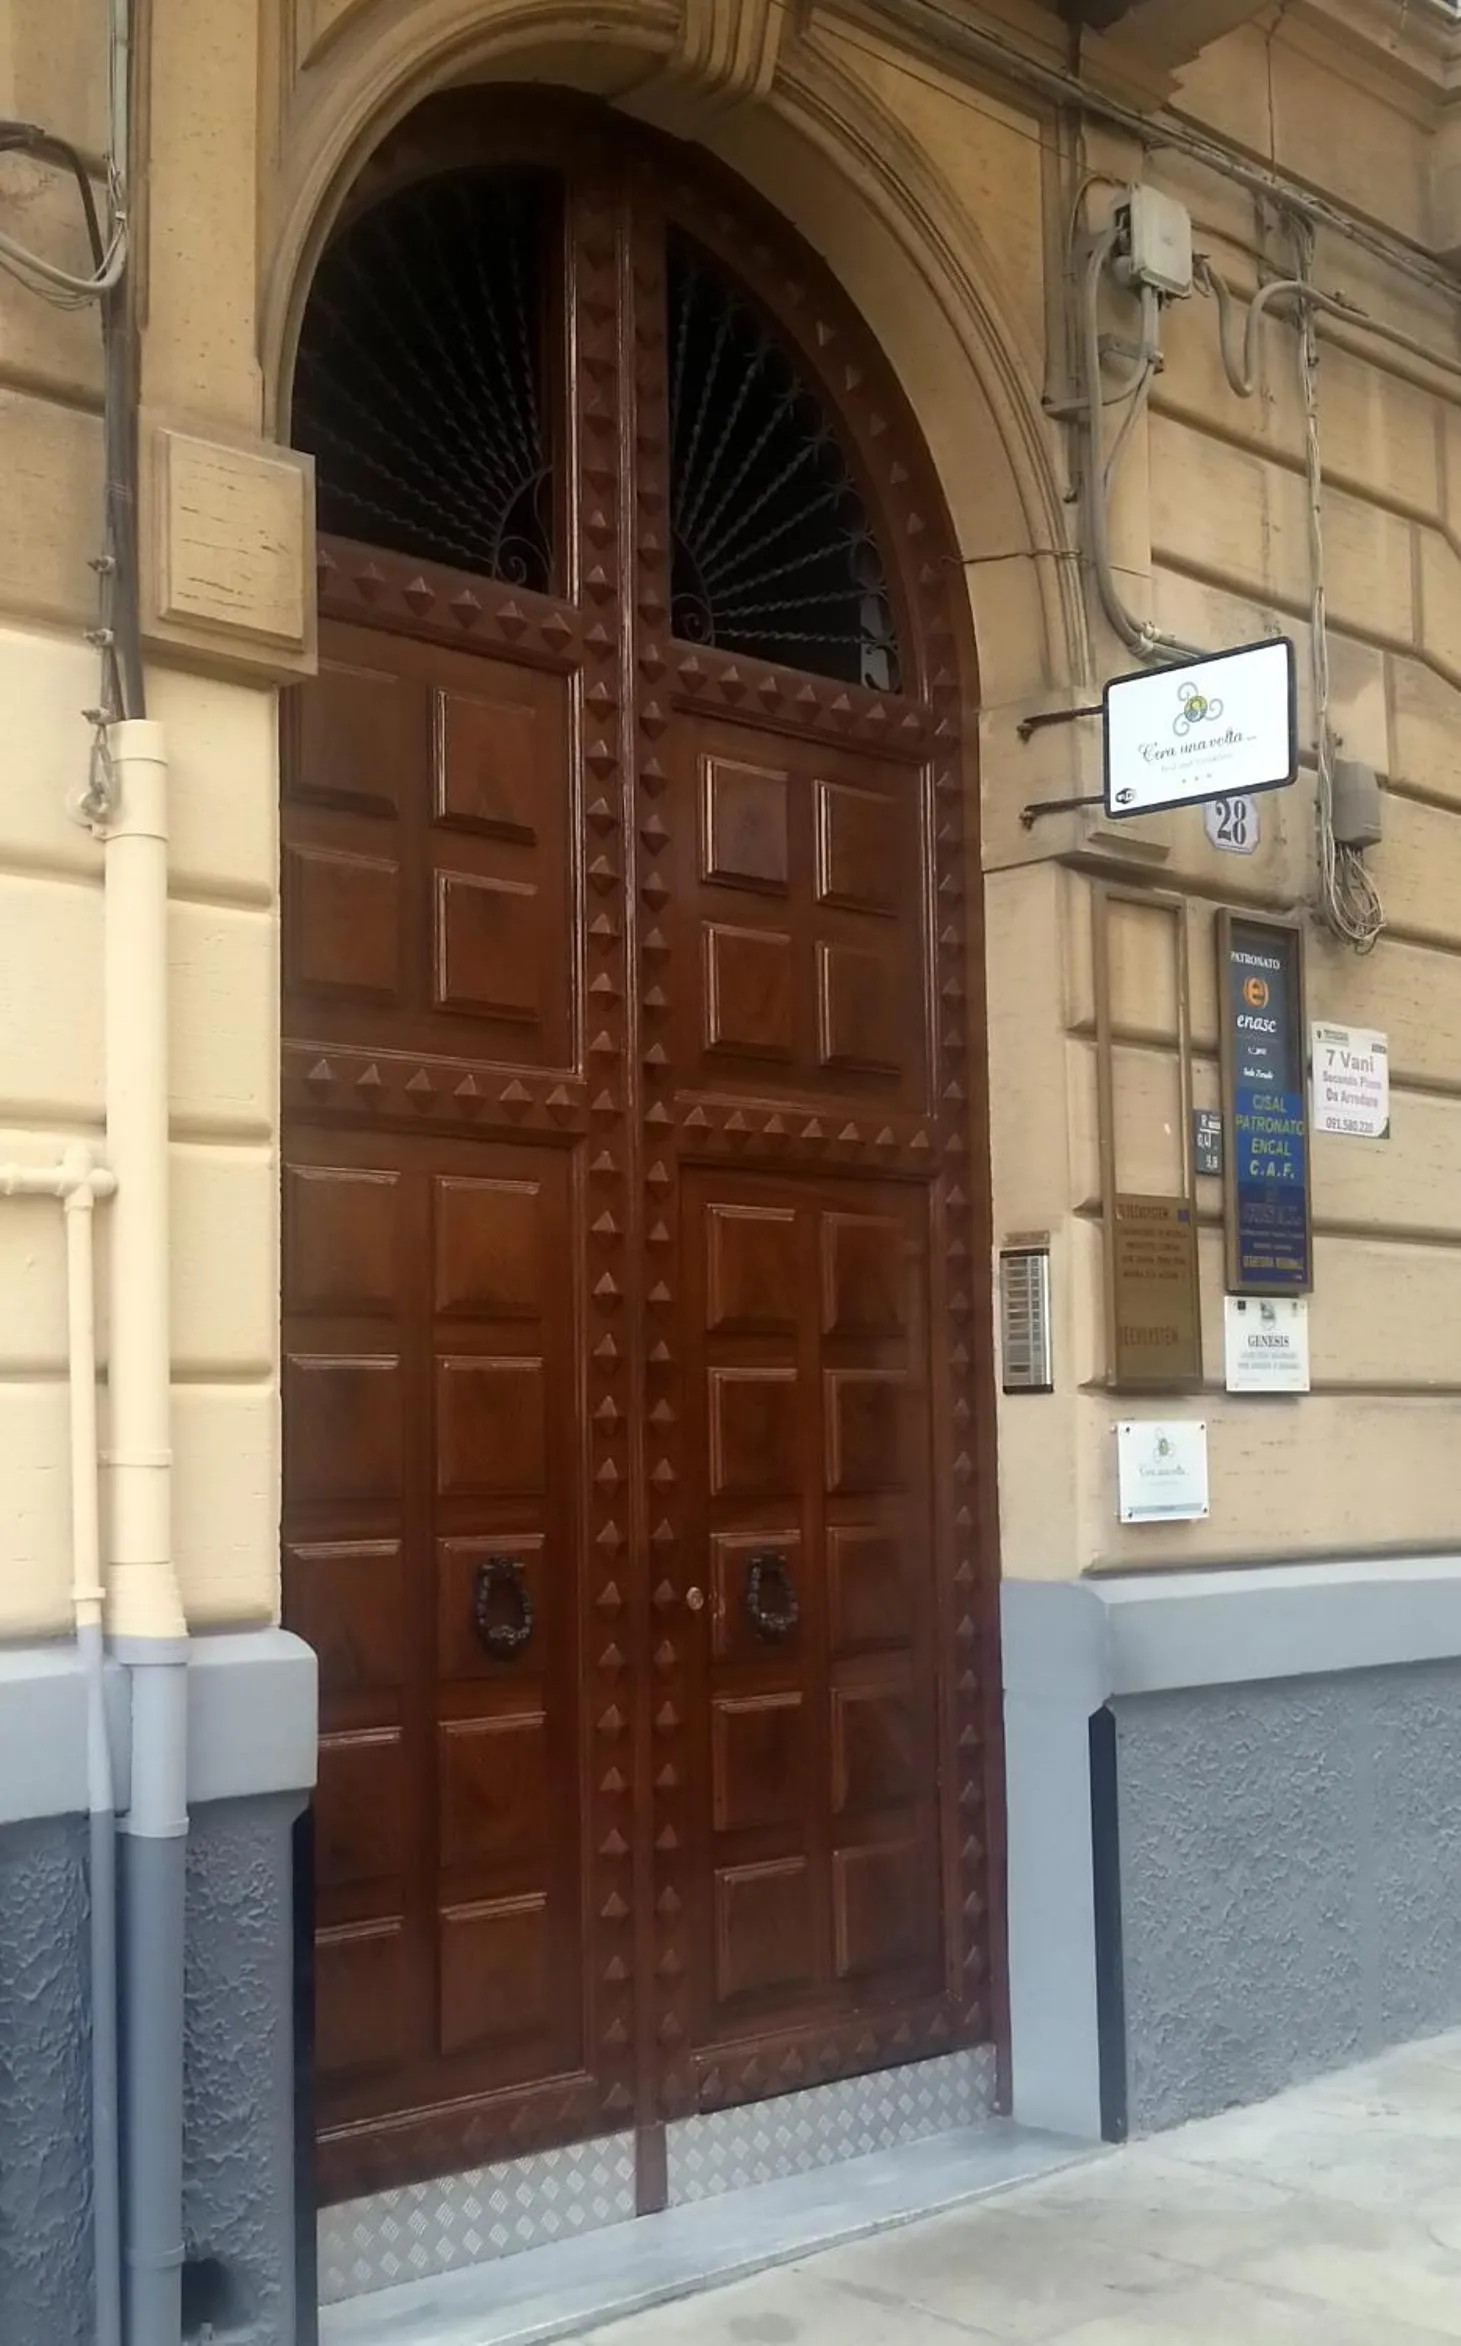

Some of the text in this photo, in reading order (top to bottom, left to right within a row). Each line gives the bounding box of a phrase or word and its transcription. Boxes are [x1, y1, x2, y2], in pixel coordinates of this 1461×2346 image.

[1181, 740, 1207, 756] una
[1215, 799, 1247, 845] 28
[1230, 951, 1281, 970] PATRONATO
[1236, 1013, 1278, 1033] enasc
[1326, 1049, 1375, 1073] 7 Vani
[1252, 1094, 1288, 1113] CISAL
[1251, 1137, 1292, 1157] ENCAL
[1249, 1159, 1295, 1179] C.A.F.
[1247, 1334, 1290, 1348] GENESIS
